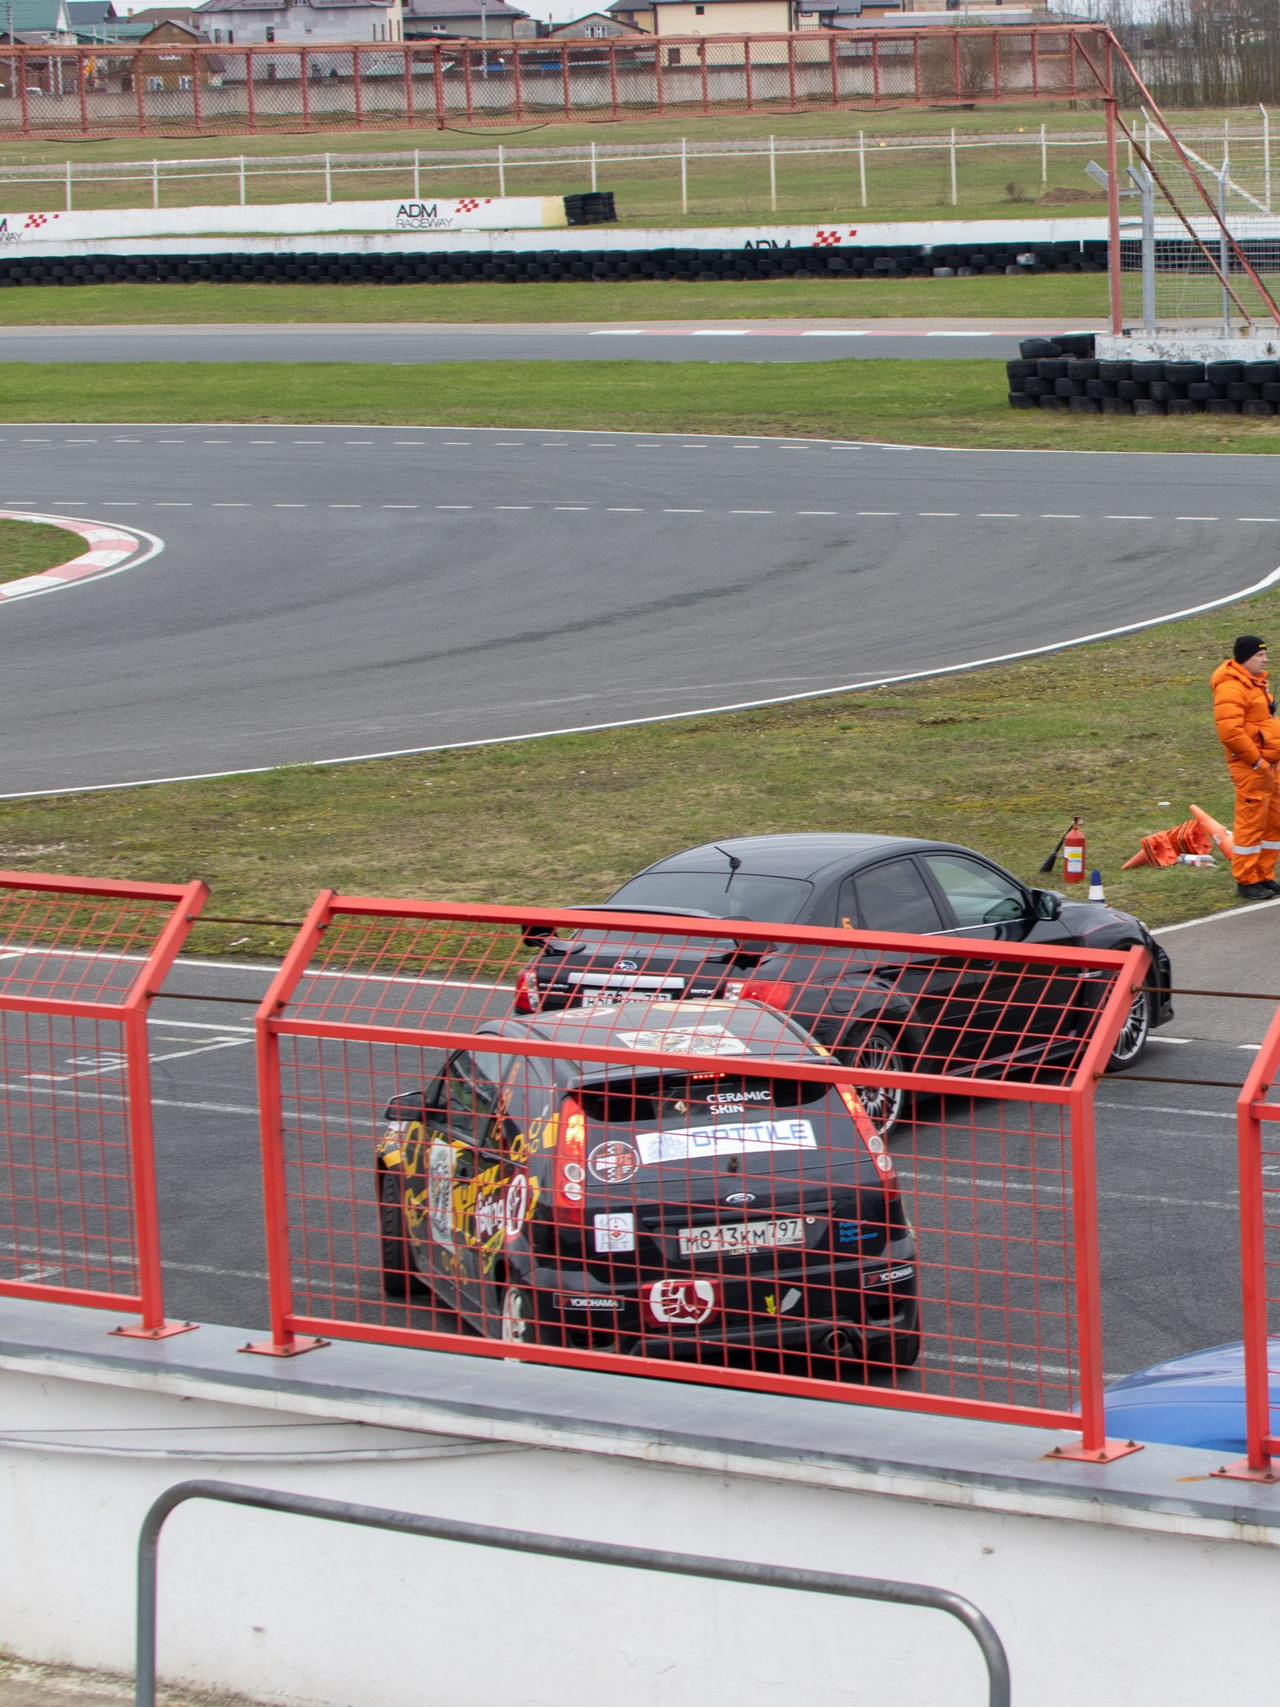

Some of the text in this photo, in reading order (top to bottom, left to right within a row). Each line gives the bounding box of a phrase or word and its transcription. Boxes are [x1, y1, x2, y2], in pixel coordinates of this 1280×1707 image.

[396, 203, 438, 218] ADM
[396, 217, 454, 229] RACEWAY
[706, 1090, 772, 1105] CERAMIC
[710, 1104, 746, 1116] SKIN
